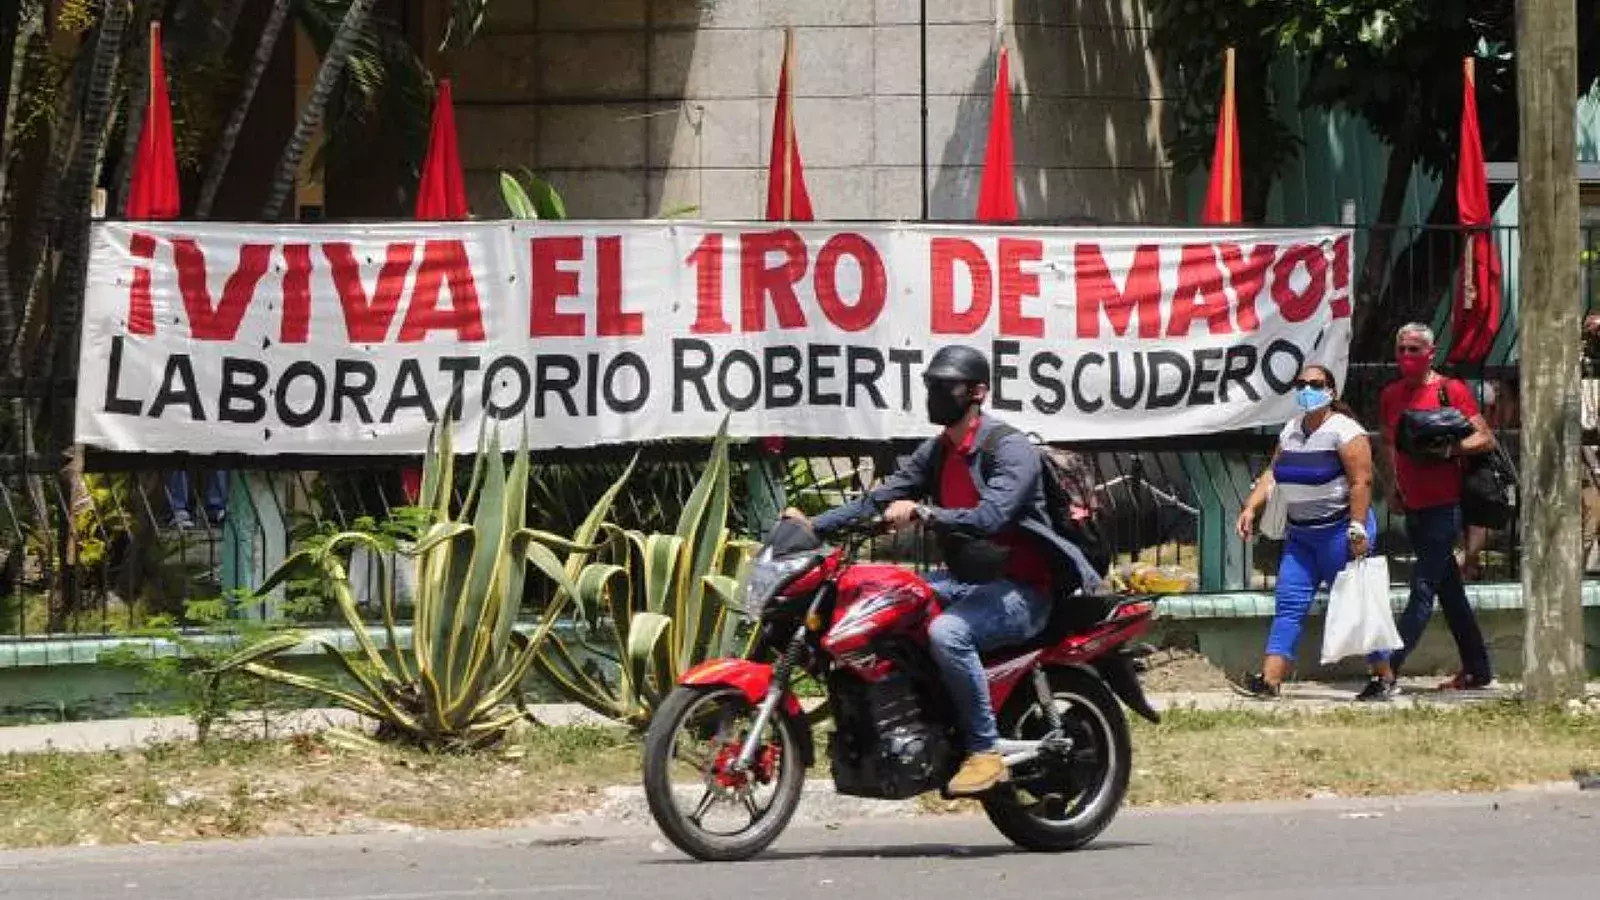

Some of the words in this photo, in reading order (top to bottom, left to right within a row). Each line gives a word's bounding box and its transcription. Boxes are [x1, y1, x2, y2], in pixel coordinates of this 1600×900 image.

[127, 233, 486, 343] ¡VIVA
[530, 235, 645, 338] EL
[685, 228, 888, 335] 1RO
[930, 237, 1044, 338] DE
[1074, 233, 1351, 340] MAYO!
[104, 336, 650, 428] LABORATORIO
[672, 338, 924, 412] ROBERT
